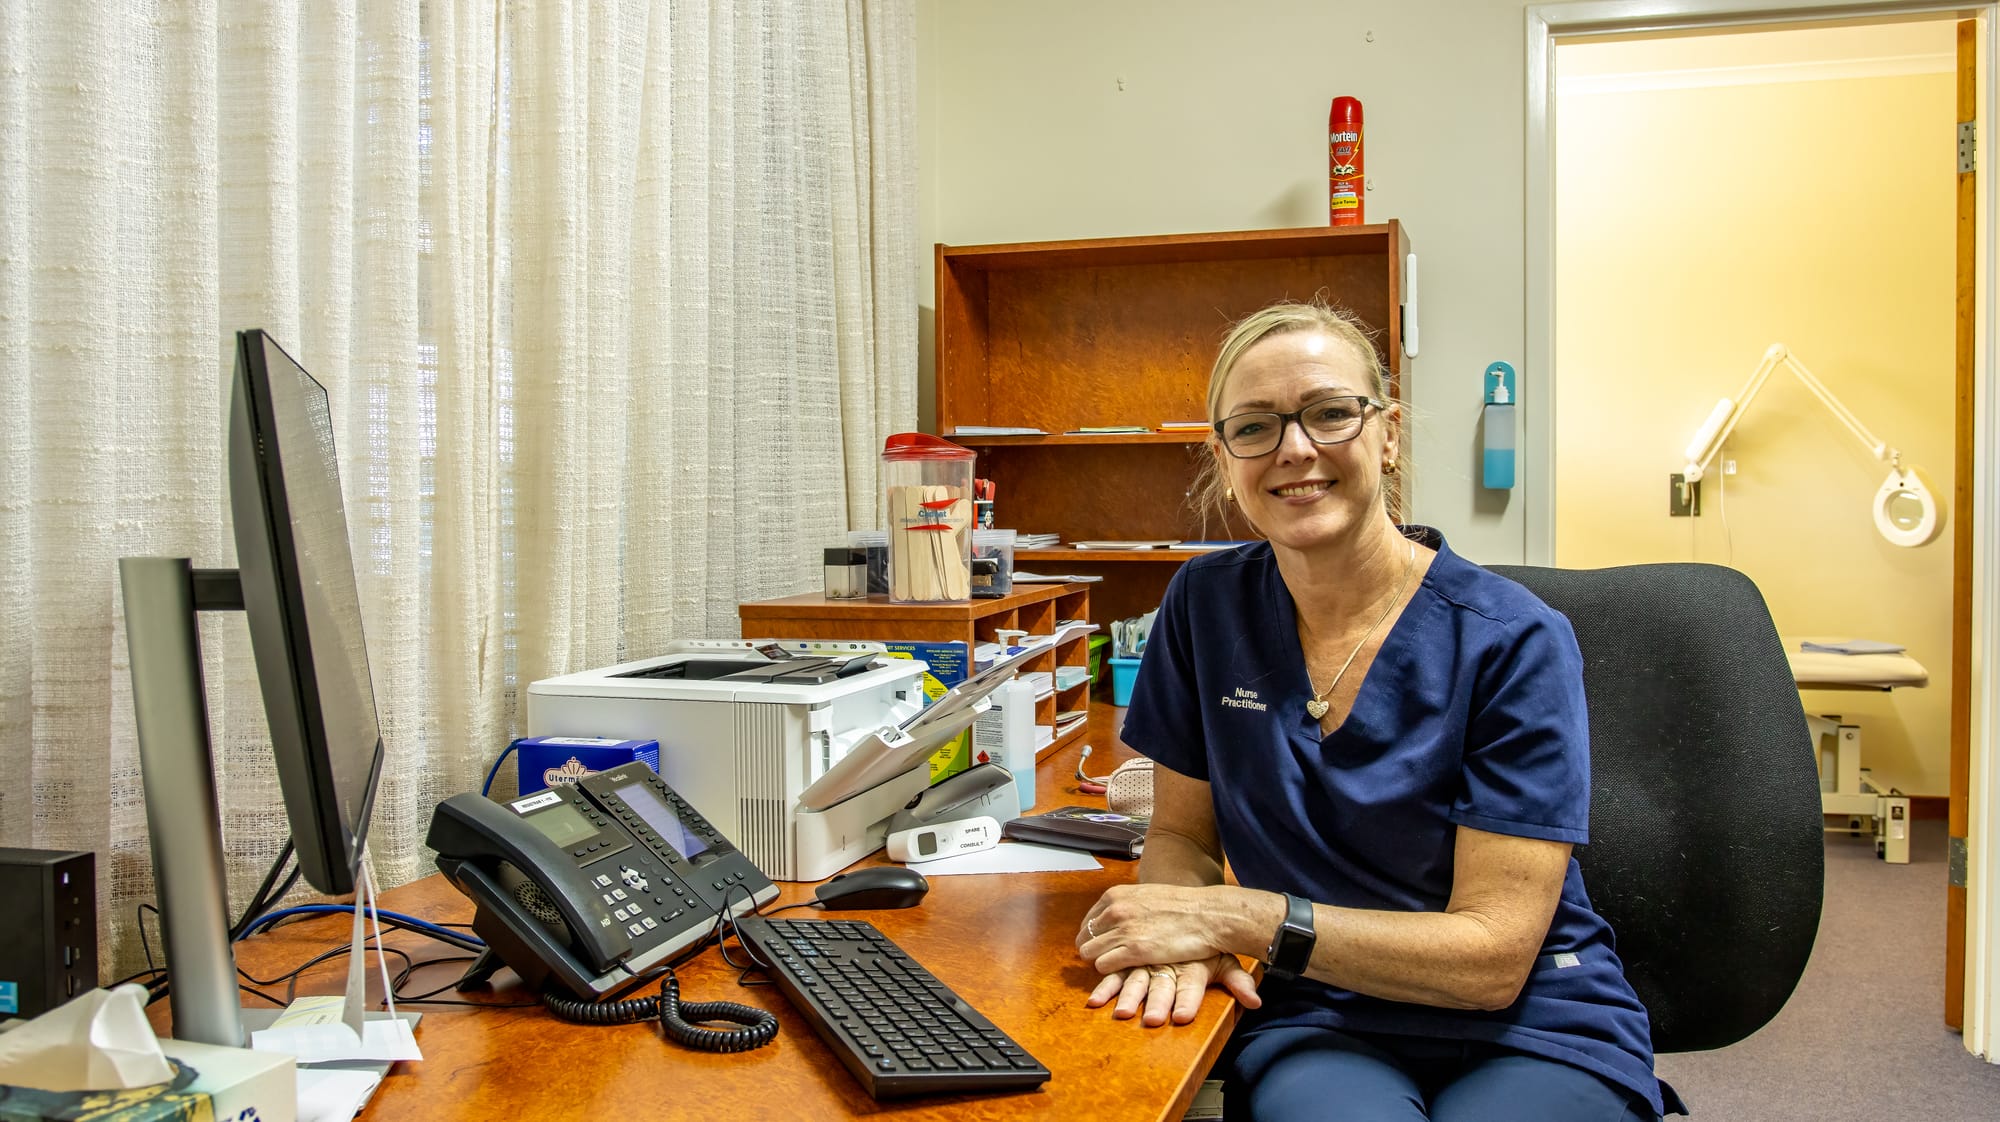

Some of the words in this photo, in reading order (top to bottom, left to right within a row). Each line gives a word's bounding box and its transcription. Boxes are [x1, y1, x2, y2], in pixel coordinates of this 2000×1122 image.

[1235, 687, 1258, 699] Nurse
[1221, 696, 1267, 712] Practitioner
[960, 841, 984, 849] CONSULT
